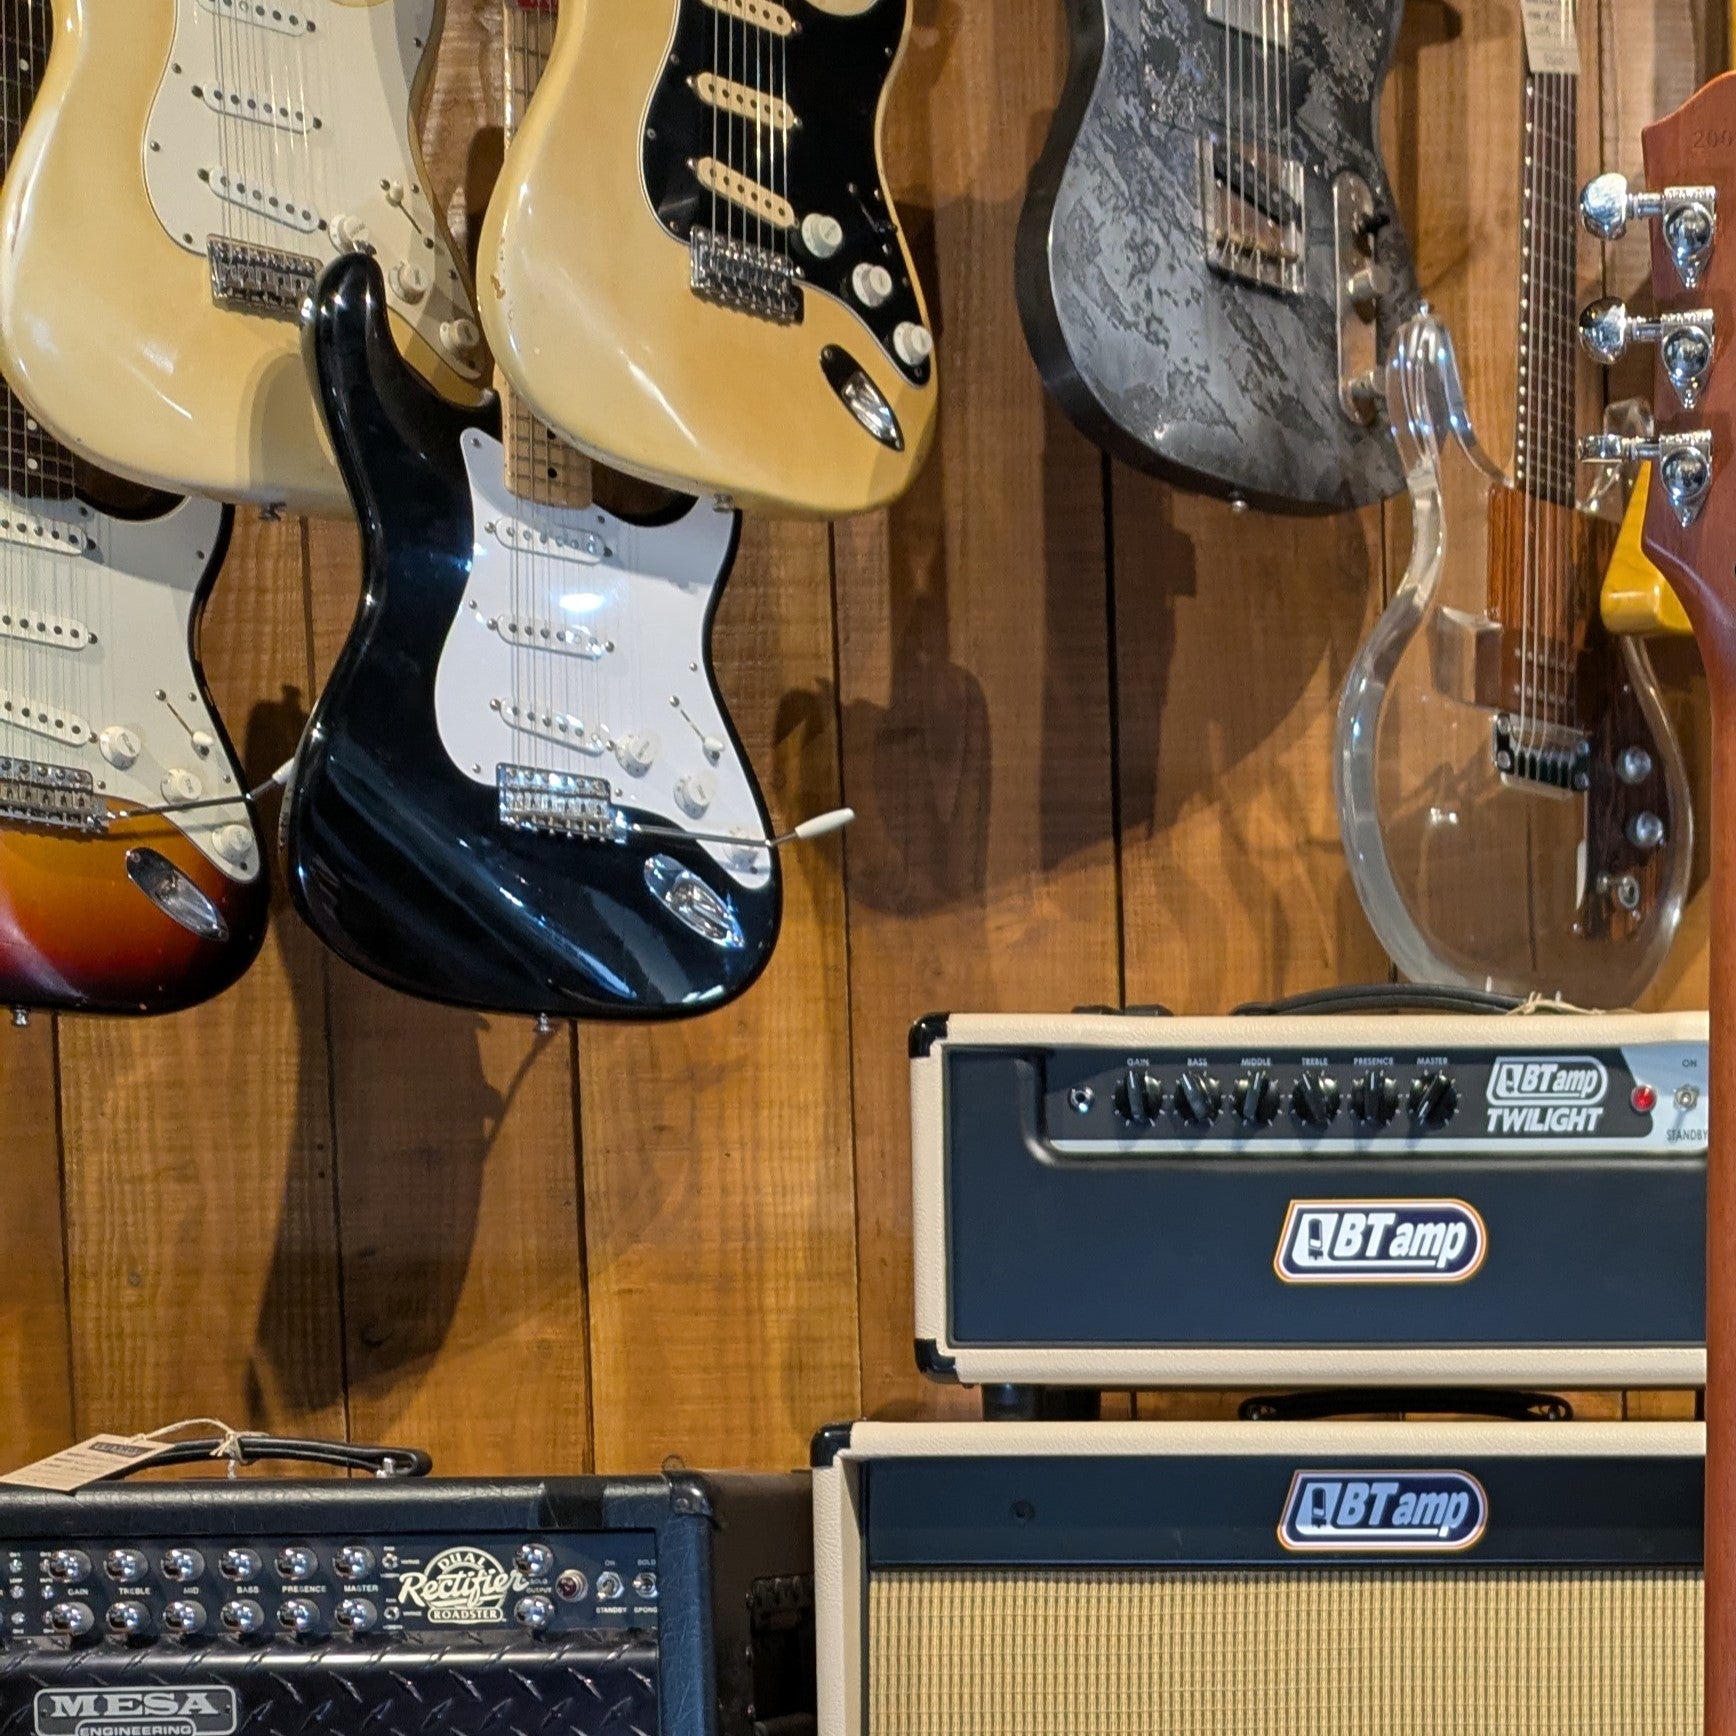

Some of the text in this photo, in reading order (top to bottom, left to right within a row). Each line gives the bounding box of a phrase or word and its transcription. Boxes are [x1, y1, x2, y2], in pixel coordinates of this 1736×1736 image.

[1126, 1057, 1149, 1067] GAIN
[1187, 1057, 1208, 1067] BASS
[1240, 1057, 1271, 1067] MIDDLE
[1302, 1057, 1328, 1067] TREBLE
[1353, 1057, 1394, 1067] PRESENCE
[1416, 1057, 1448, 1067] MASTER
[1682, 1058, 1698, 1068] ON
[1486, 1106, 1604, 1133] TWILIGHT
[1666, 1128, 1709, 1141] STANDBY
[437, 1552, 486, 1571] DUAL
[637, 1559, 657, 1567] BOLD
[67, 1587, 89, 1596] GAIN
[118, 1586, 151, 1596] TREBLE
[183, 1586, 200, 1595] MID
[236, 1585, 259, 1594] BASS
[281, 1584, 328, 1594] PRESENCE
[343, 1583, 379, 1593] MASTER
[398, 1568, 530, 1609] Rectifier
[433, 1610, 498, 1620] ROADSTER
[595, 1606, 627, 1614] STANDBY
[633, 1606, 658, 1614] SPONG
[50, 1692, 219, 1718] MESA
